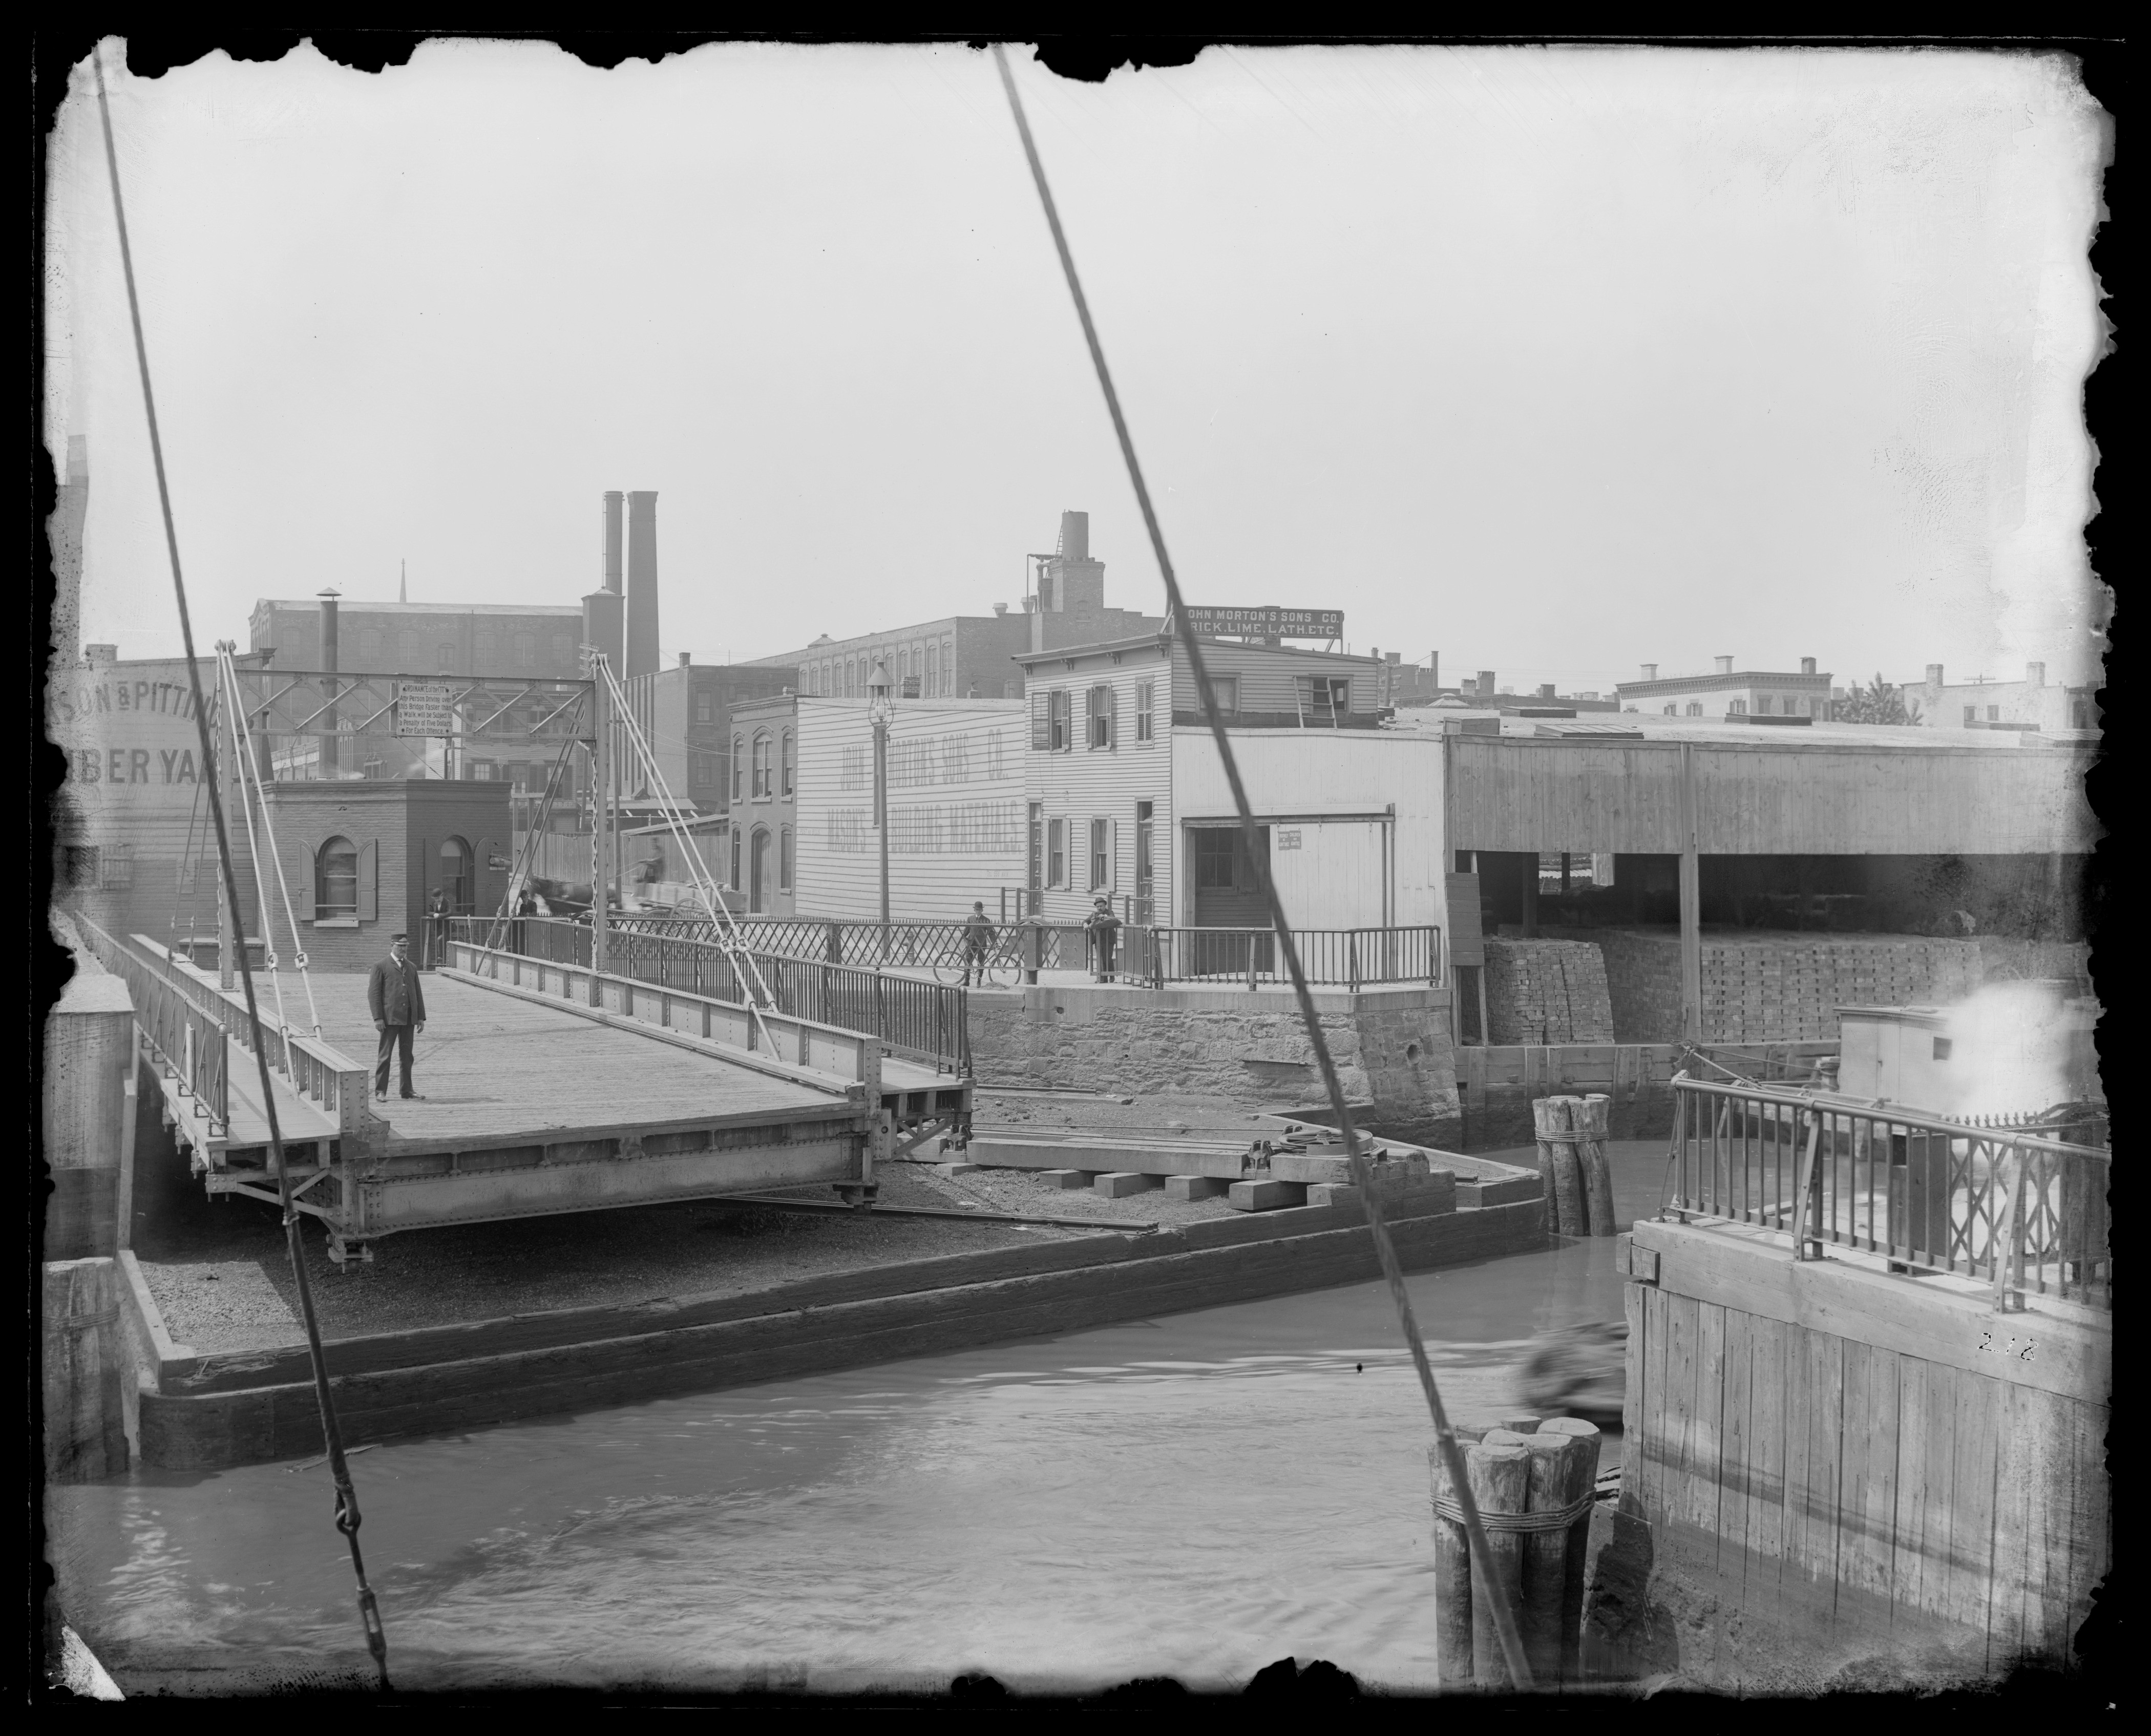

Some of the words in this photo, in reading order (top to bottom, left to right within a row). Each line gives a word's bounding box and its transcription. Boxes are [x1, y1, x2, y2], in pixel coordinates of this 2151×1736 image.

[1188, 609, 1211, 619] OHN
[1217, 610, 1277, 621] MORTON'S
[1281, 612, 1312, 622] SONS
[1322, 613, 1339, 623] CO.
[58, 684, 112, 723] SON
[405, 685, 428, 693] ORDINANCE
[404, 719, 419, 728] Penalty
[72, 749, 150, 784] BER
[840, 746, 864, 791] JOHN
[943, 733, 968, 784] SONS
[828, 808, 866, 854] MASON'S
[892, 805, 943, 855] BUILDING
[950, 800, 1021, 855] MATERIALS.
